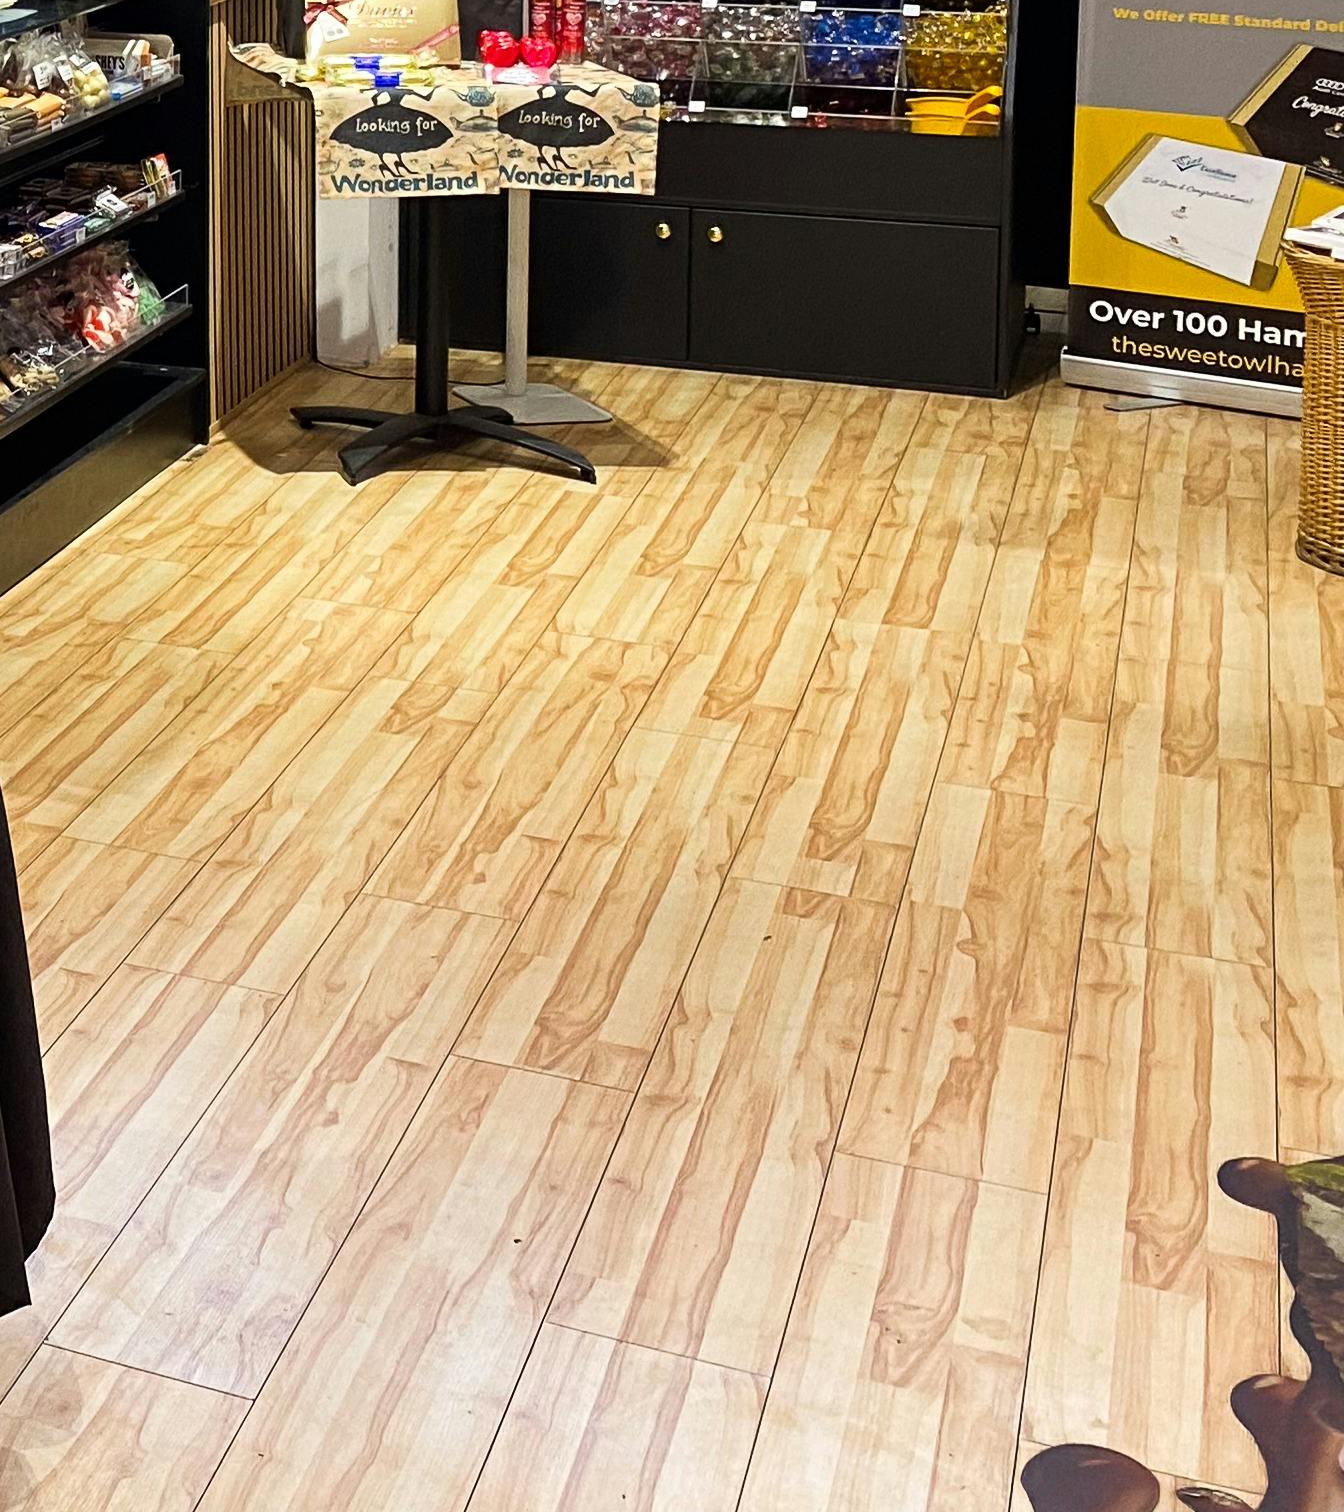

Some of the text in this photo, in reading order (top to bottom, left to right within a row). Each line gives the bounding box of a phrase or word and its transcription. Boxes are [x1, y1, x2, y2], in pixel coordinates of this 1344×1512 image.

[1113, 8, 1311, 31] We Offer FREE Standard
[355, 116, 438, 136] Looking for
[518, 110, 600, 133] Looking for
[331, 171, 479, 195] Wonderland
[1089, 299, 1164, 330] Over
[1172, 310, 1228, 338] 100
